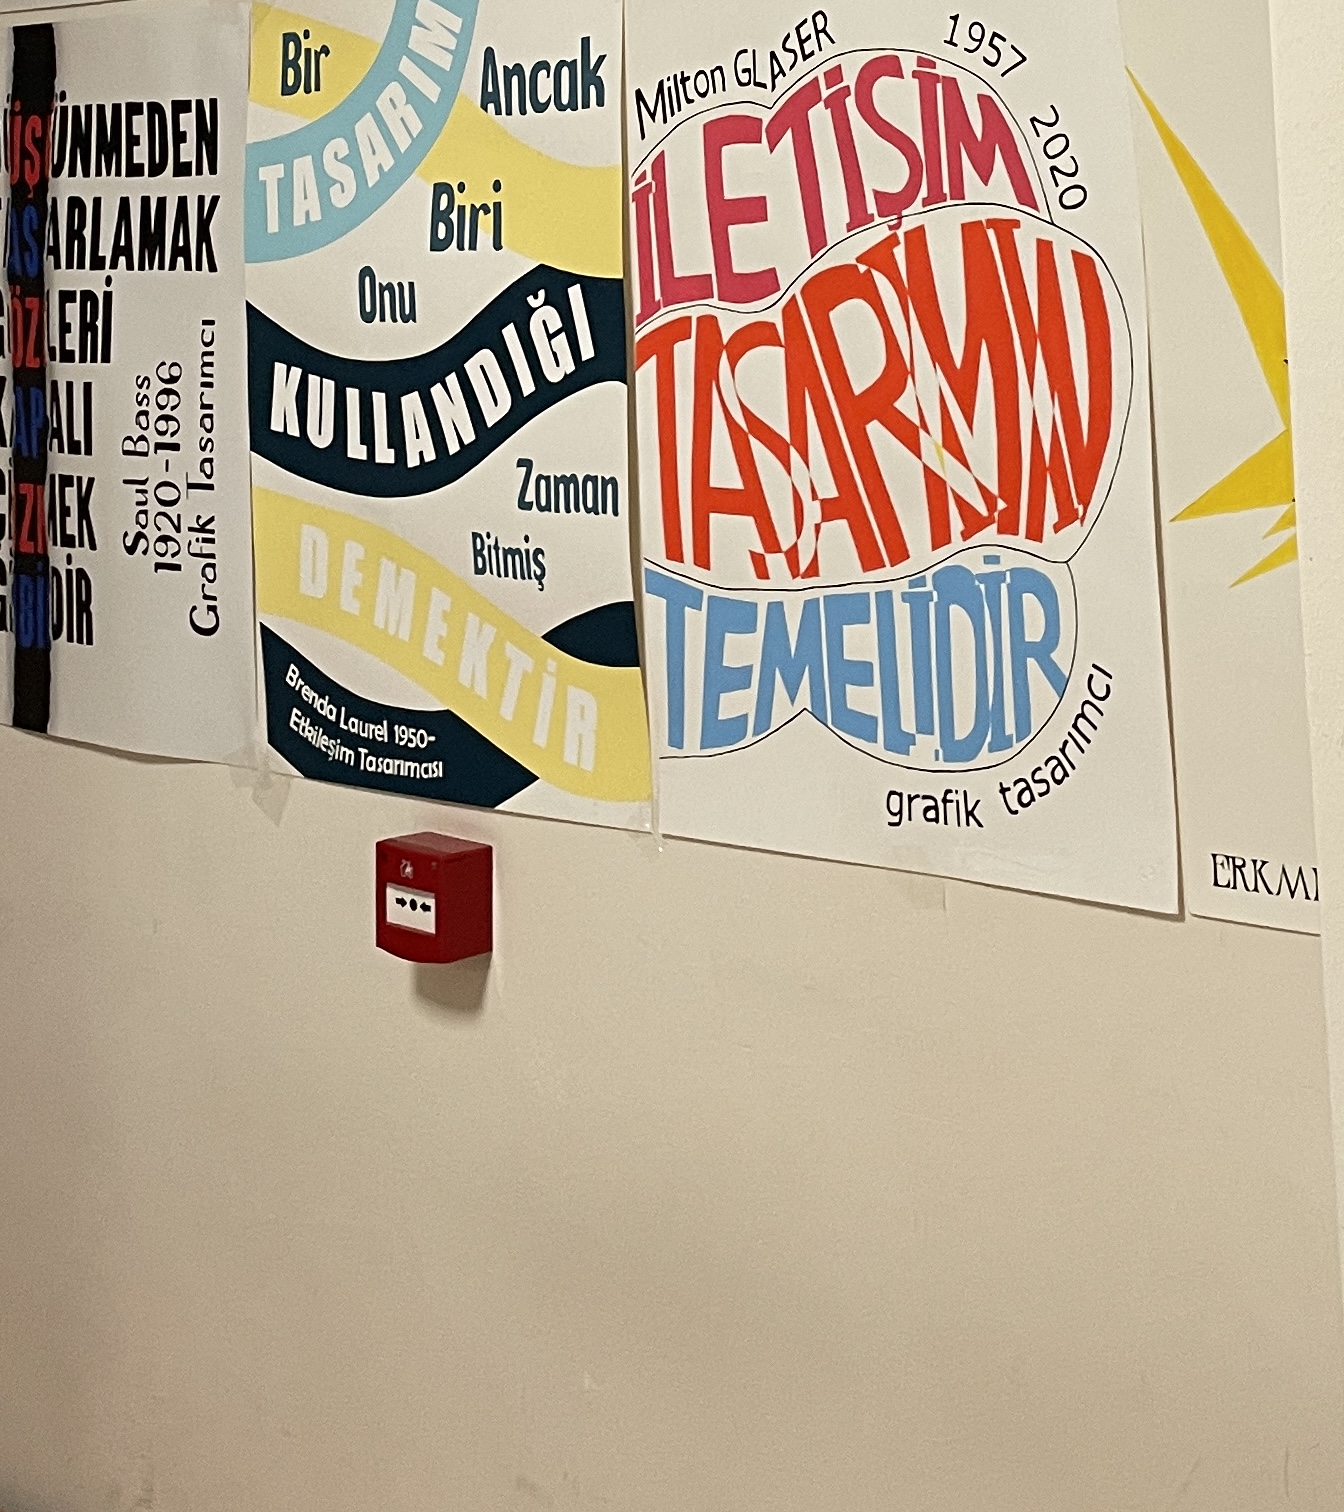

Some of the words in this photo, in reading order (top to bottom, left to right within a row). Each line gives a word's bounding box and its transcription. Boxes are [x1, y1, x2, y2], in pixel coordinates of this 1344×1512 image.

[280, 29, 331, 97] Bir
[480, 35, 608, 117] Ancak
[633, 65, 727, 141] Milton
[733, 9, 837, 91] GLASER
[942, 13, 1028, 78] 1957
[631, 54, 1040, 329] İLETİŞİM
[1028, 104, 1089, 211] 2020
[429, 179, 504, 253] Biri
[357, 265, 417, 325] Onu
[121, 374, 151, 457] Bass
[186, 319, 216, 500] Tasarımcı
[269, 282, 596, 470] KULLANDIĞI
[153, 360, 183, 574] 1920-1996
[515, 457, 620, 518] Zaman
[121, 476, 150, 557] Saul
[188, 514, 221, 637] Grafik
[470, 530, 547, 592] Bitmiş
[298, 522, 600, 773] DEMEKTİR
[644, 553, 1068, 764] TEMELİDİR
[285, 663, 337, 722] Brenda
[339, 706, 388, 744] Laurel
[393, 724, 436, 749] 1950-
[289, 707, 355, 767] Etkileşim
[358, 747, 443, 779] Tasarımcısı
[885, 788, 985, 829] grafik
[998, 663, 1114, 817] tasarımcı
